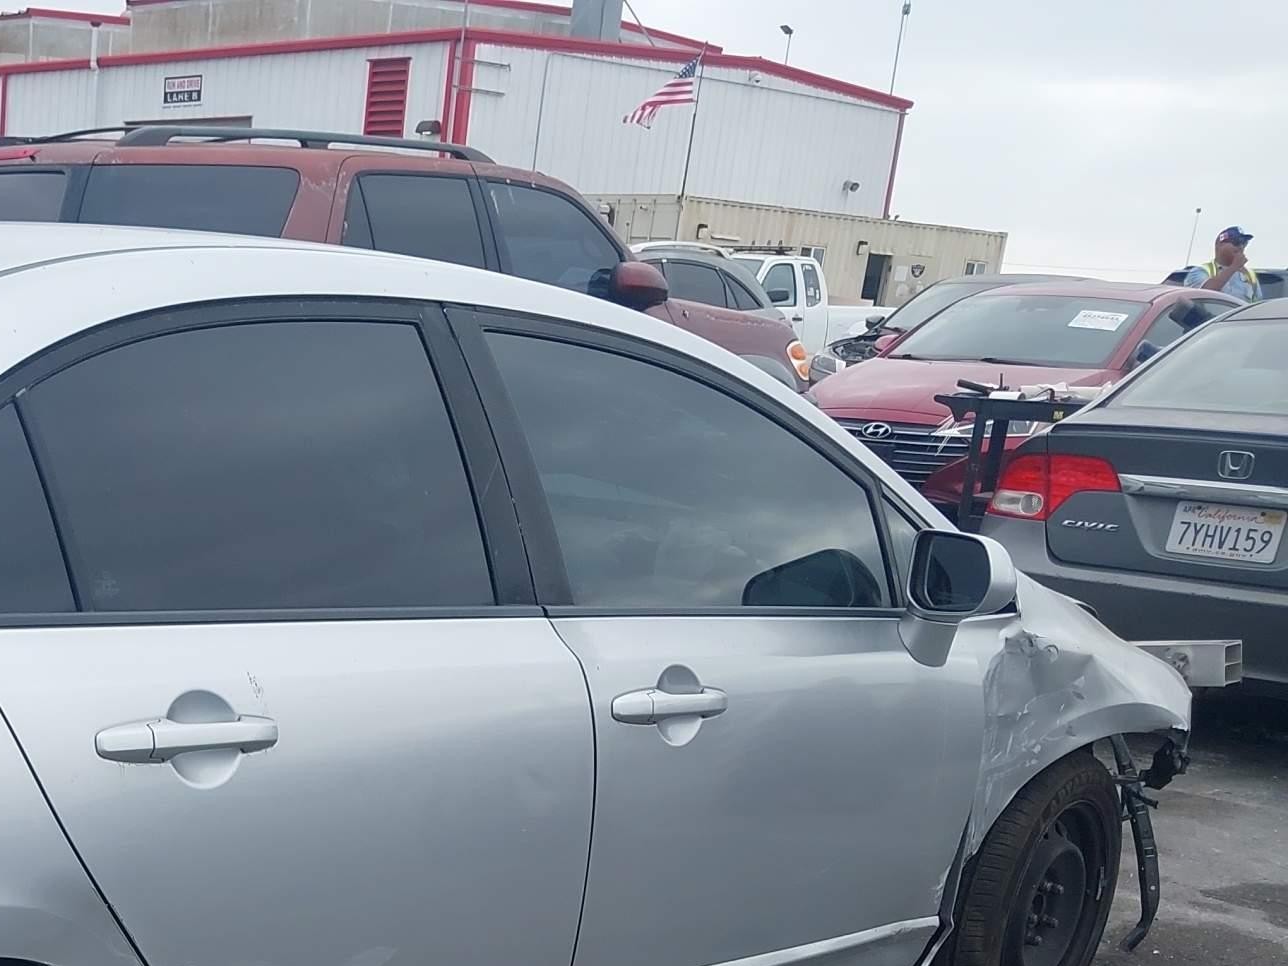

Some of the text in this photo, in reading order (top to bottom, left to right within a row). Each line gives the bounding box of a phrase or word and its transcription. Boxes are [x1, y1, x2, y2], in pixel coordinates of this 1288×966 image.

[167, 92, 191, 102] LANE
[1196, 505, 1265, 524] California
[1062, 519, 1120, 532] CIVIC
[1178, 521, 1273, 555] 7YHV159
